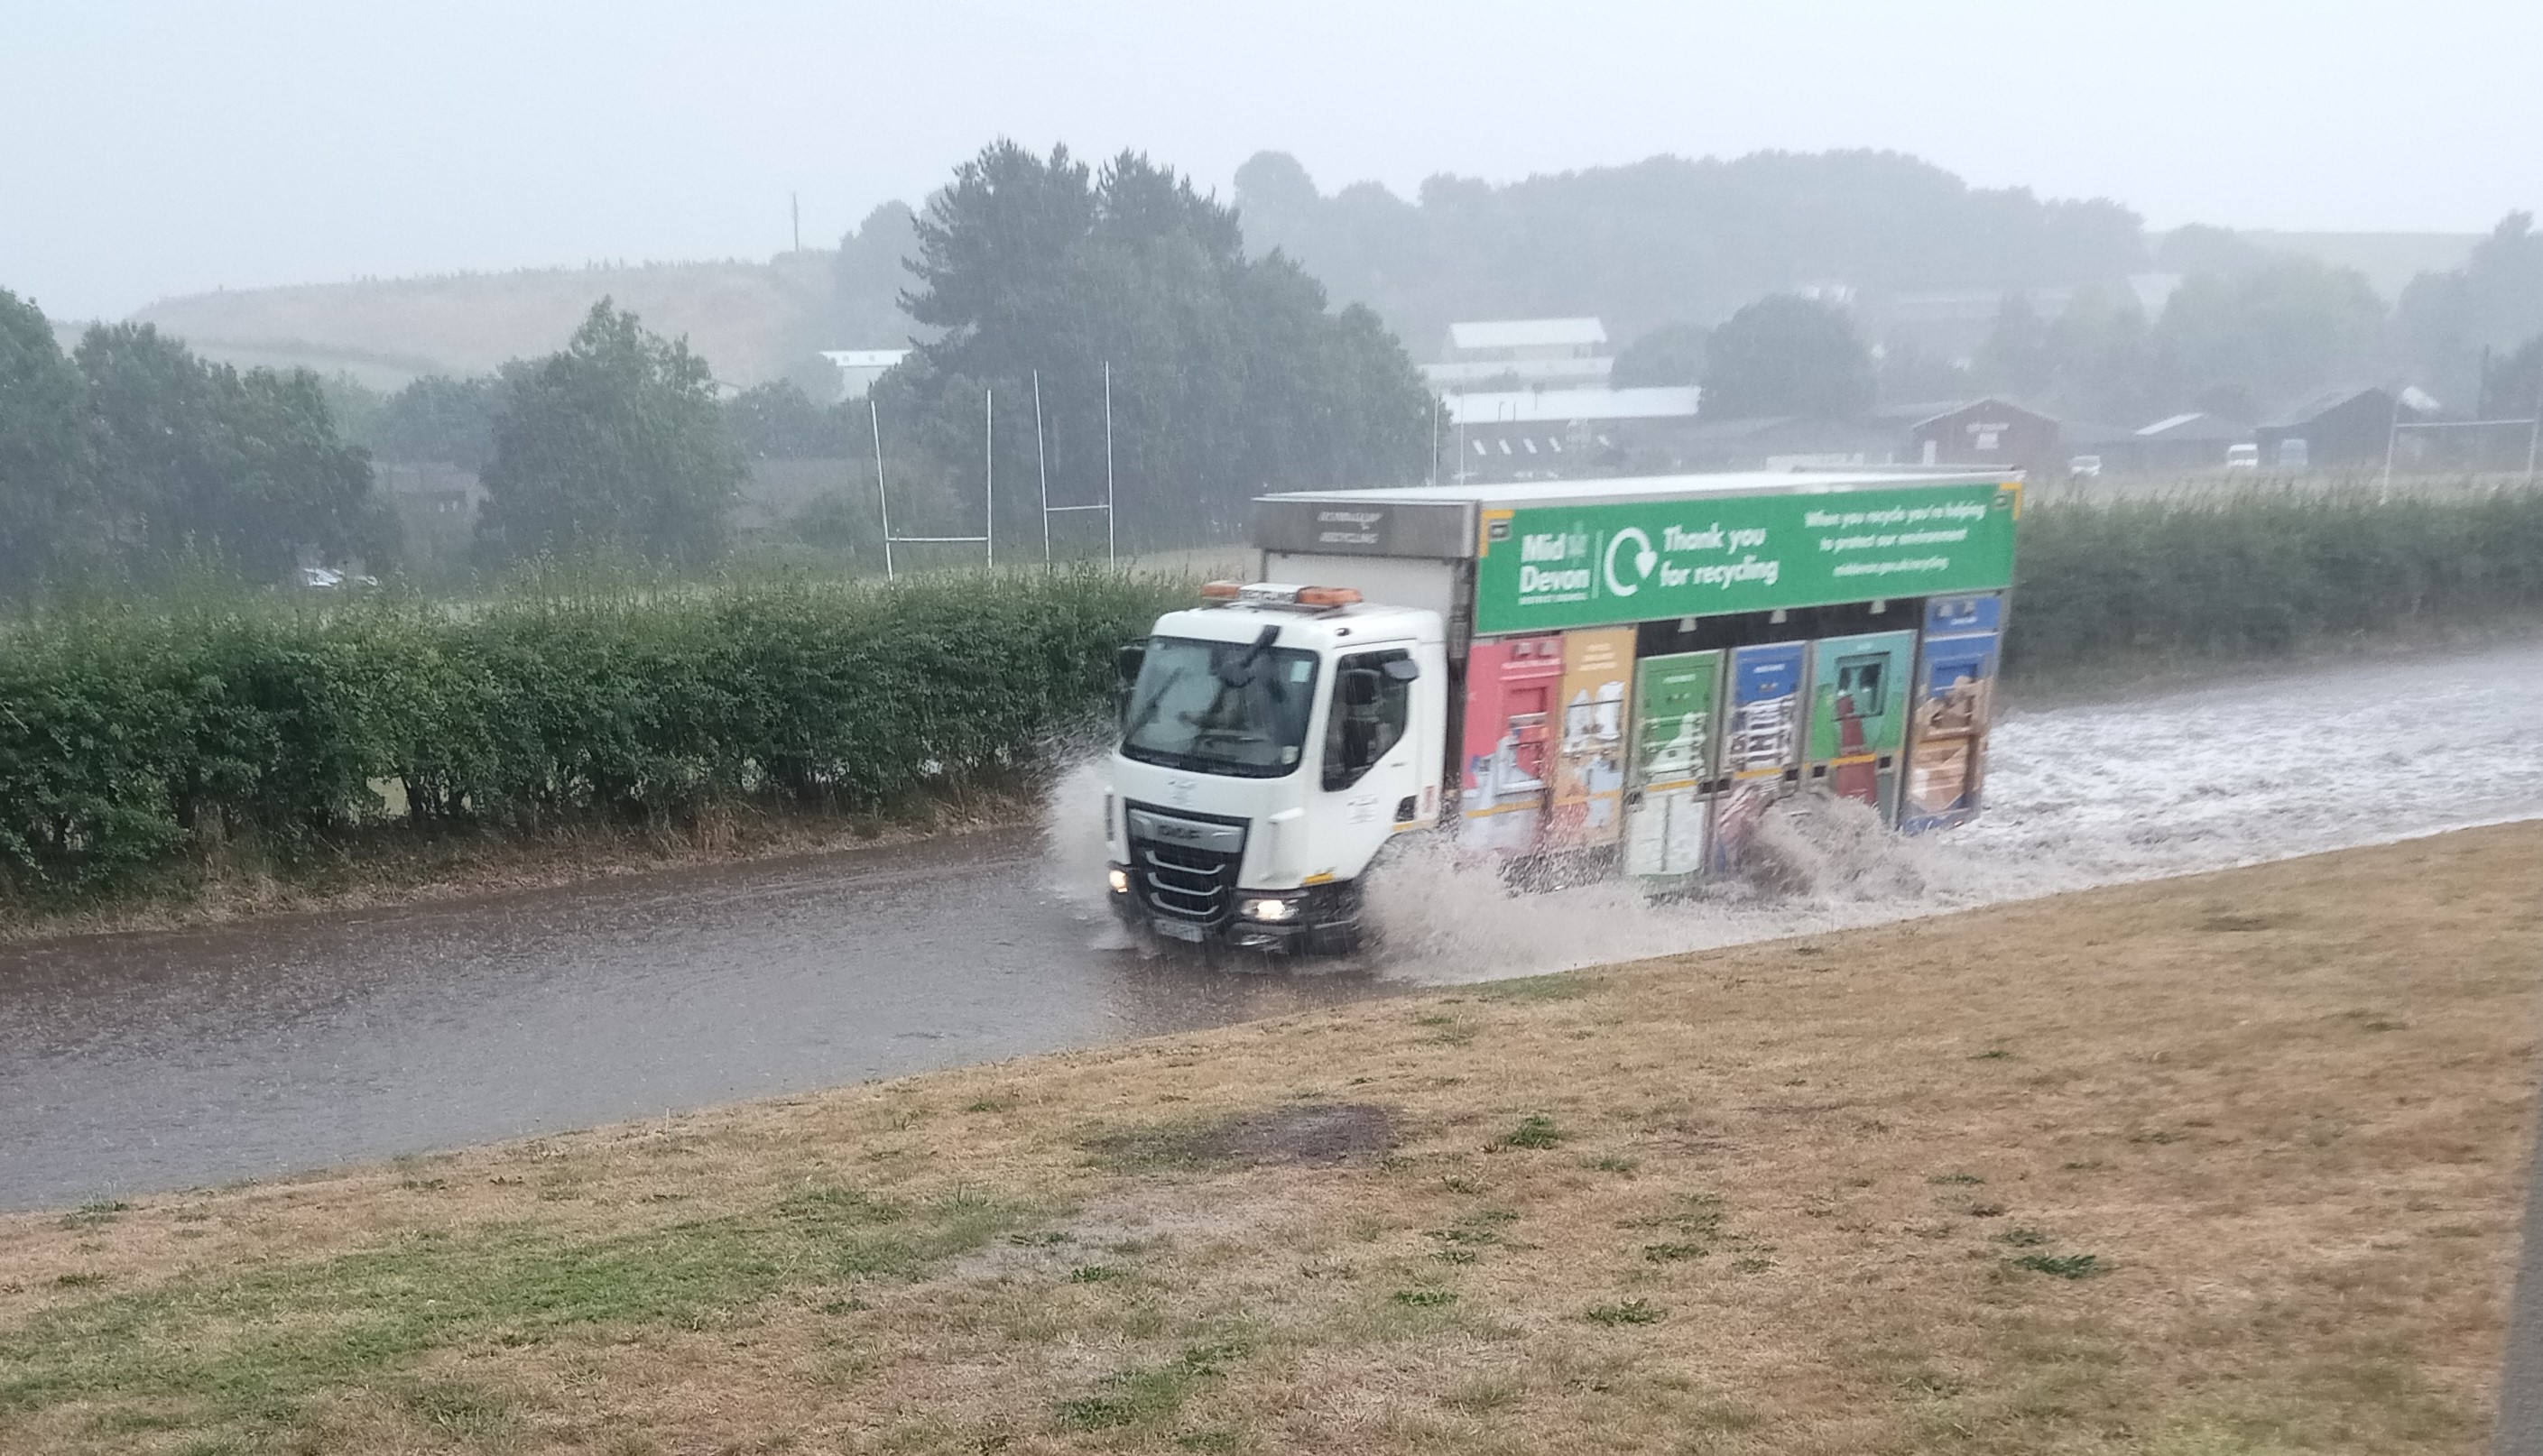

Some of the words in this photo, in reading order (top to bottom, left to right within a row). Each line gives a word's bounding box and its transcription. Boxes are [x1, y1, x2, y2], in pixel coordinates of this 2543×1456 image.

[1840, 512, 1865, 530] you
[1520, 532, 1567, 563] Mid
[1663, 522, 1725, 553] Thank
[1727, 527, 1767, 555] you
[1519, 565, 1591, 594] Devon
[1660, 560, 1692, 587] for
[1693, 555, 1780, 590] recycling
